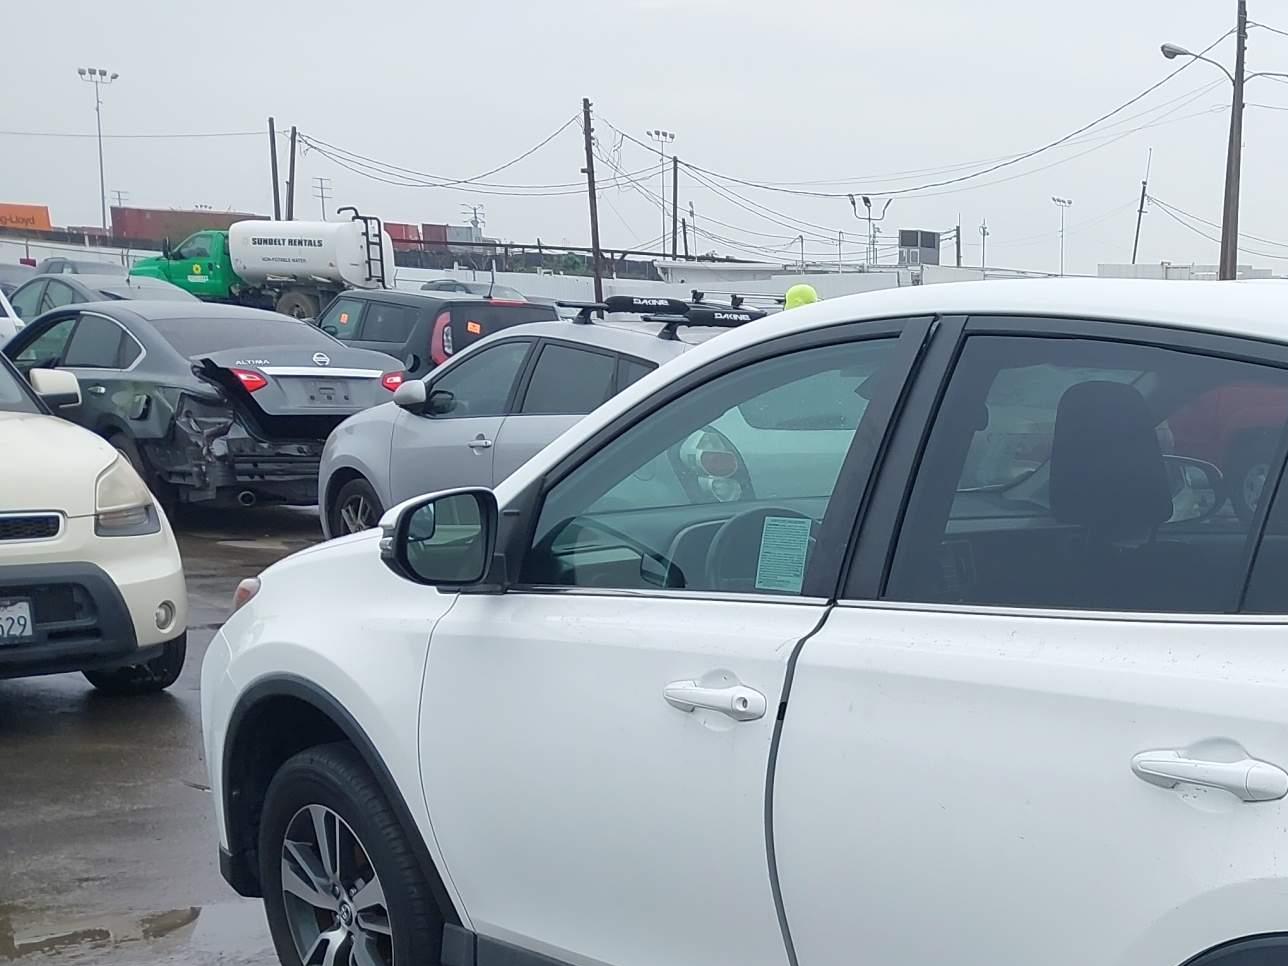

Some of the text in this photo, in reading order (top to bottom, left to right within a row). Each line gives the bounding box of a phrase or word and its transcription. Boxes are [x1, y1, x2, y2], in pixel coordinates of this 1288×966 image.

[252, 237, 323, 247] SUNBELT RENTALS
[633, 298, 669, 306] DAKINE
[714, 313, 751, 321] DAKINE
